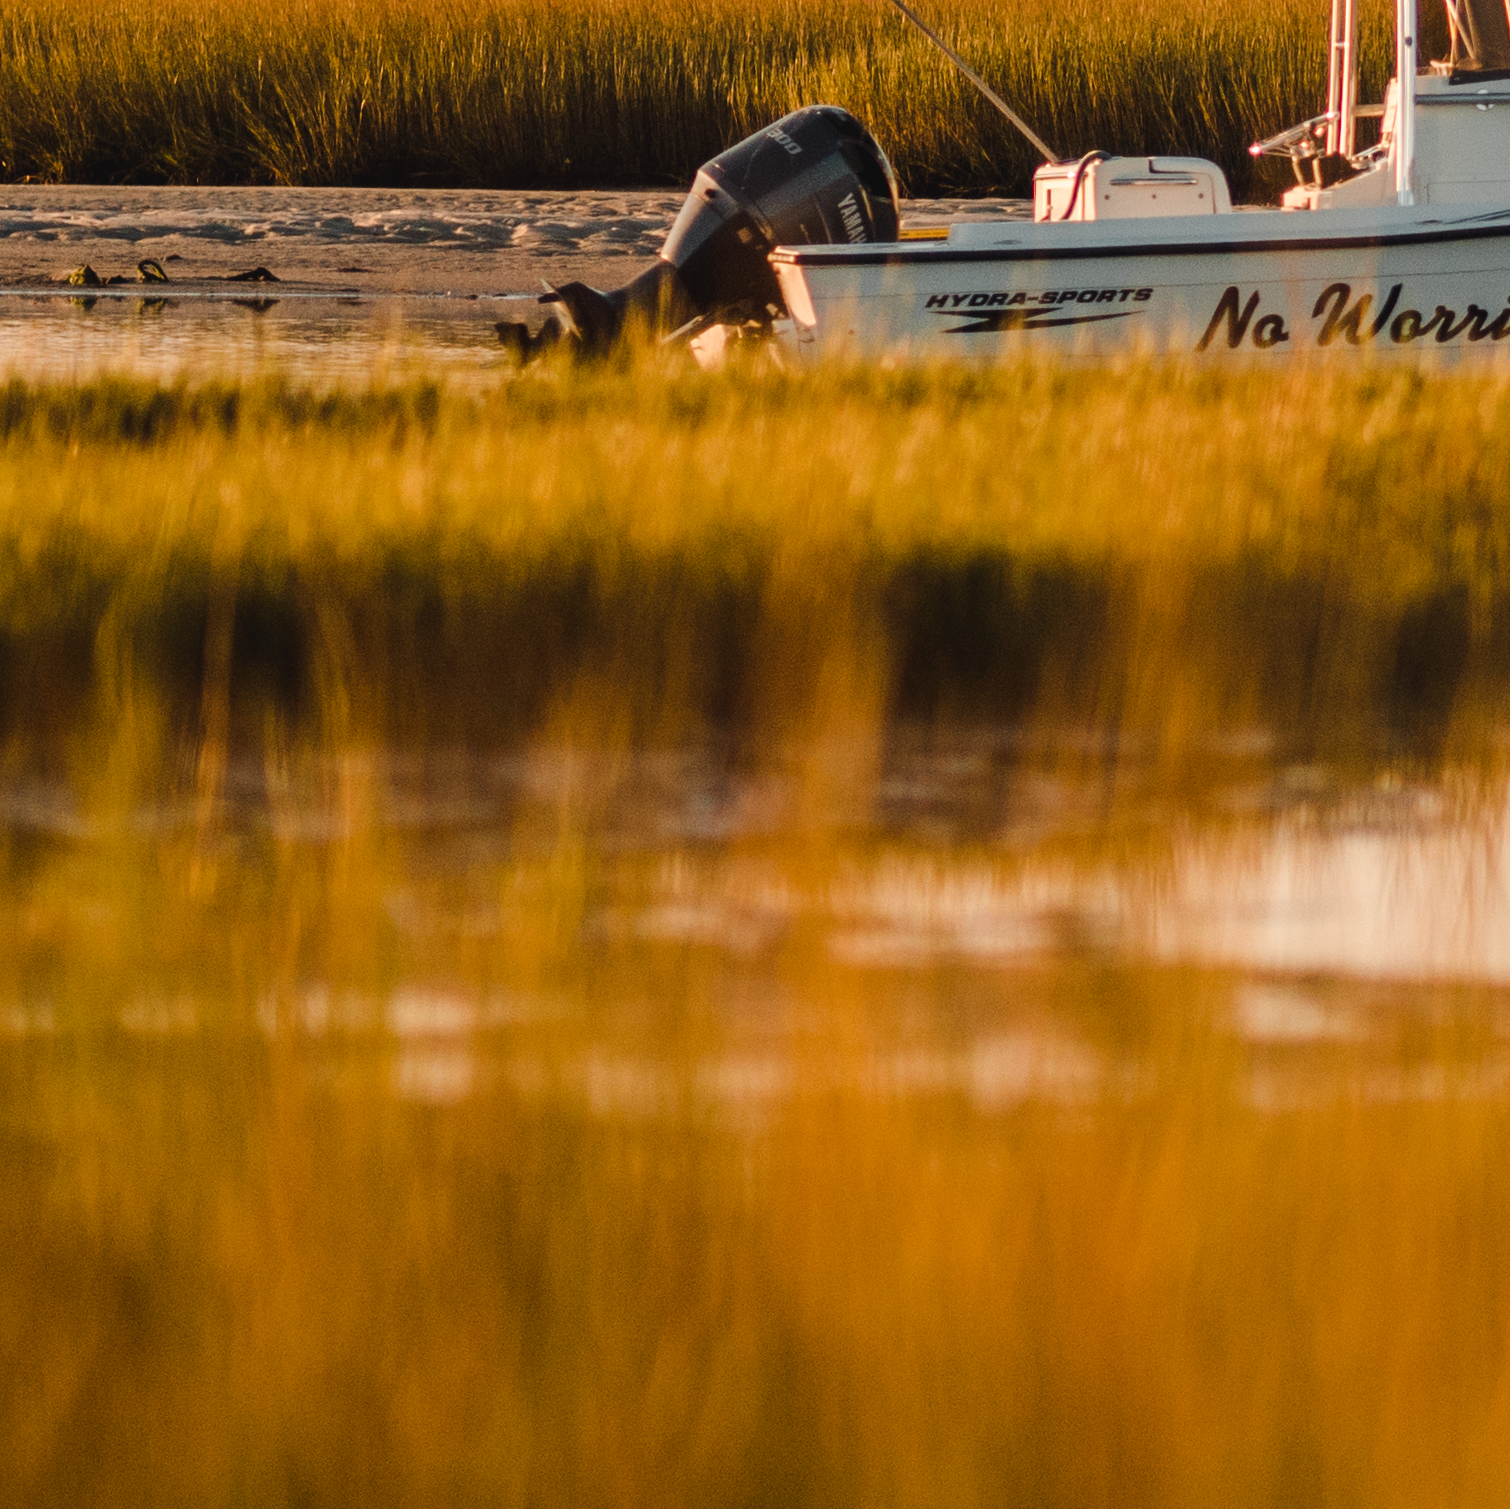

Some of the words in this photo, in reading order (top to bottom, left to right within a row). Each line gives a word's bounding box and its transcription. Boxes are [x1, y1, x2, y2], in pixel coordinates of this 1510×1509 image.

[837, 192, 868, 244] YAMAH
[925, 288, 1154, 309] HYDRA-SPORTS
[1193, 286, 1290, 352] No
